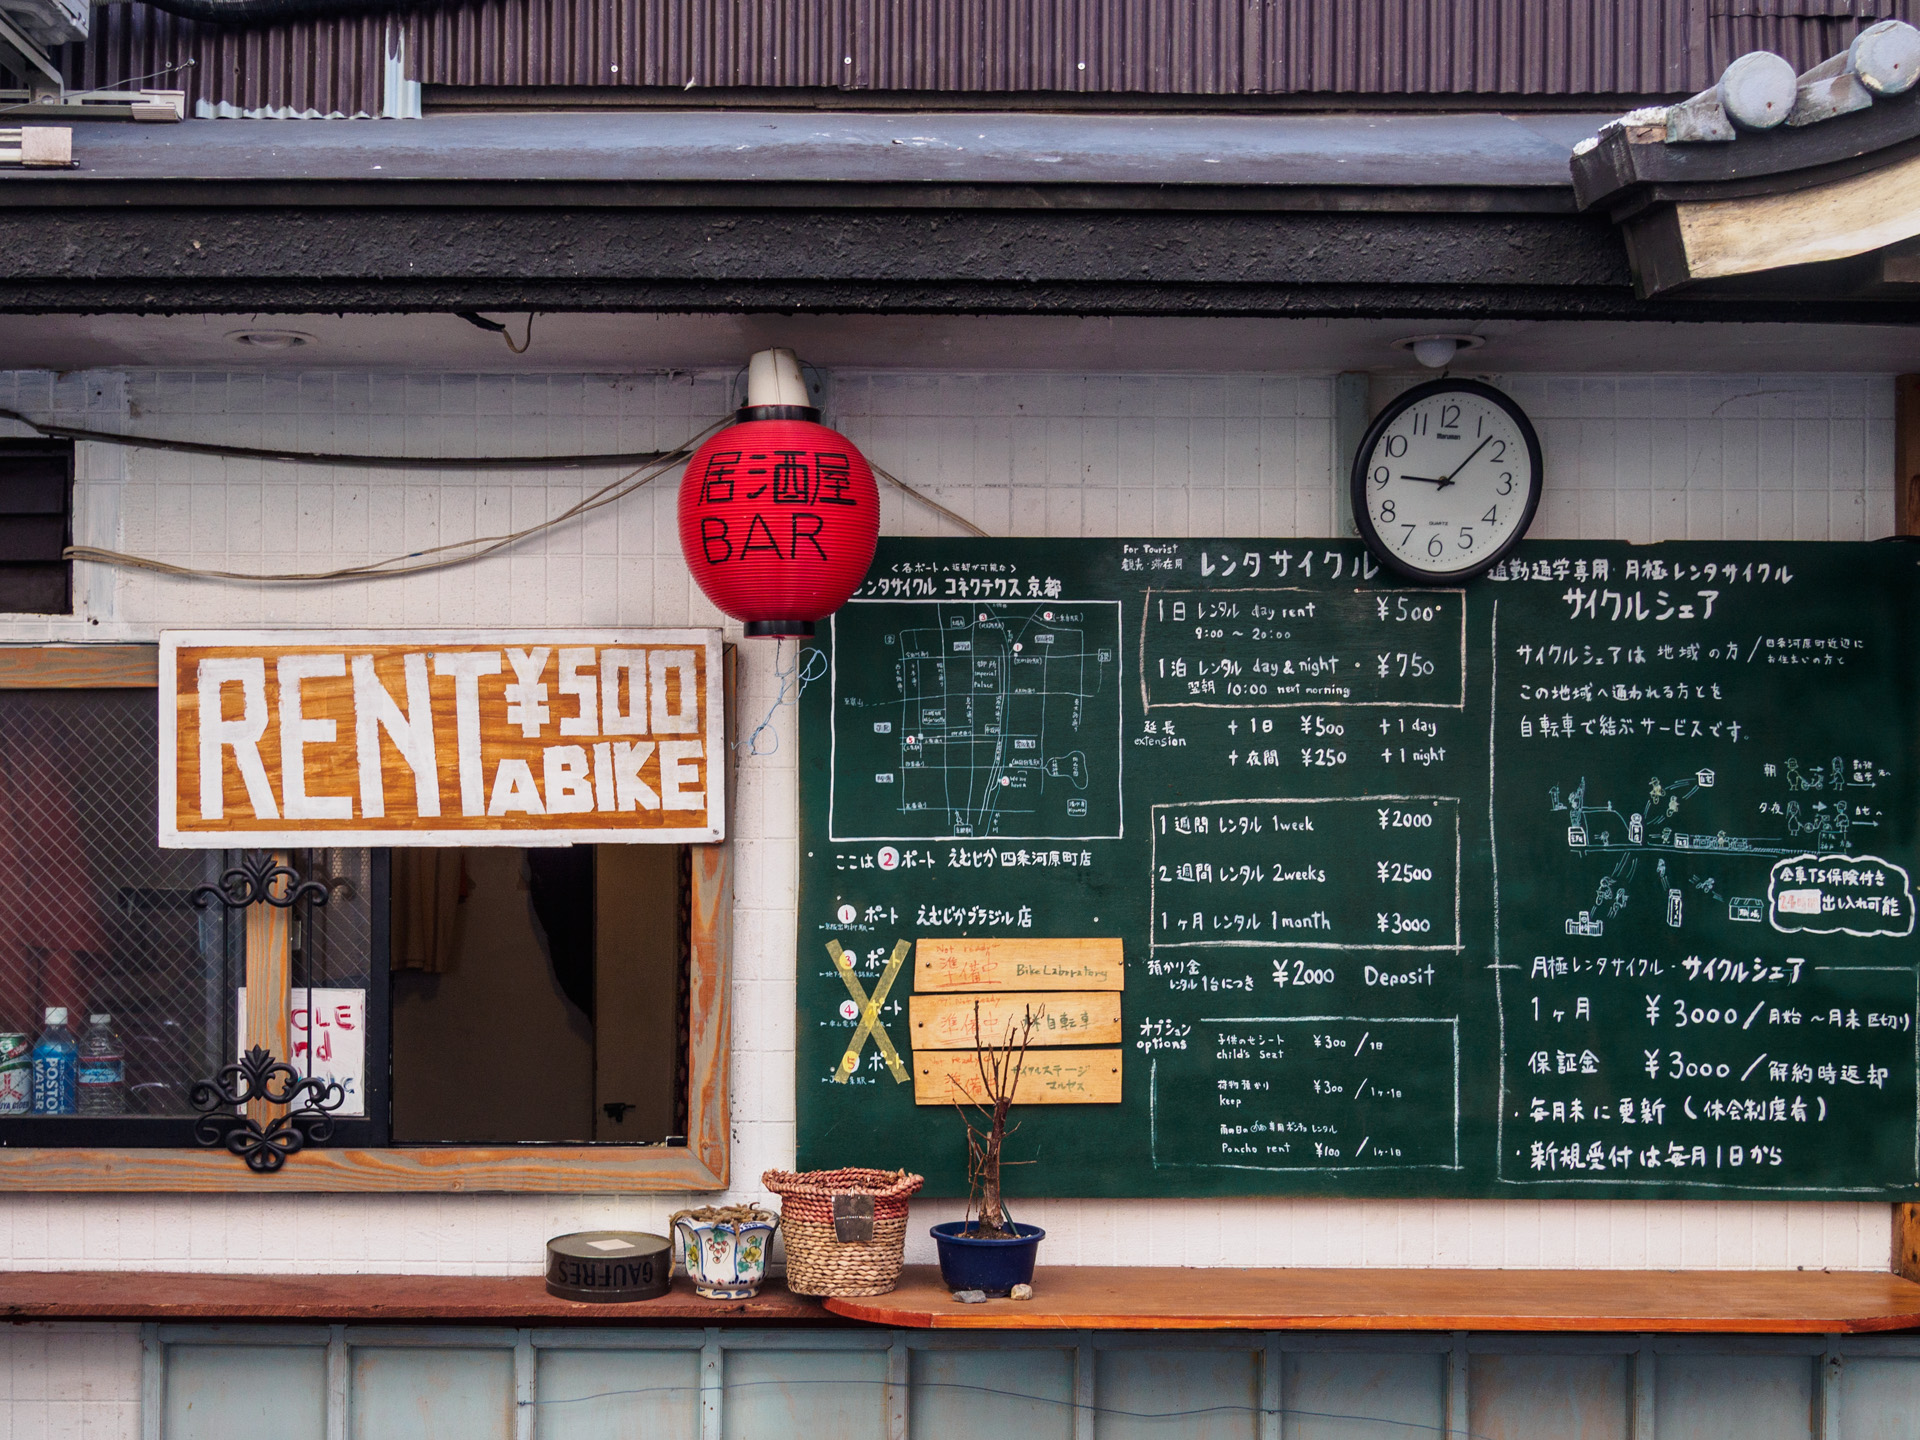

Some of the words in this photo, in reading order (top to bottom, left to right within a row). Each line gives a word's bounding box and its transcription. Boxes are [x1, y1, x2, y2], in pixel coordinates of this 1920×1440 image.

[1413, 413, 1427, 435] 11
[1441, 405, 1460, 428] 12
[1477, 415, 1482, 438] 1
[1385, 435, 1408, 457] 10
[1490, 440, 1506, 463] 2
[697, 449, 858, 507] 居酒屋
[1374, 466, 1389, 490] 9
[1496, 471, 1512, 495] 3
[1380, 500, 1396, 522] 8
[1481, 504, 1497, 526] 4
[702, 511, 829, 565] BAR
[1401, 524, 1416, 546] 7
[1428, 533, 1443, 557] 6
[1457, 527, 1473, 549] 5
[1123, 544, 1139, 554] For
[1143, 543, 1179, 554] Tourist
[1201, 551, 1383, 580] レンタサイクル
[1027, 576, 1062, 599] 京都
[1198, 601, 1240, 620] レンタル
[1251, 603, 1274, 620] day
[1282, 602, 1316, 618] rent
[1376, 596, 1434, 622] ¥500
[1563, 588, 1720, 622] サイクルシェア
[1195, 627, 1223, 640] 9:00
[1251, 628, 1291, 640] 20:00
[1199, 658, 1242, 677] レンタル
[1253, 659, 1279, 677] day
[1299, 657, 1340, 677] night
[1377, 652, 1435, 678] ¥750
[1188, 679, 1216, 695] 翌朝
[1227, 681, 1268, 696] 10:00
[1277, 682, 1300, 695] next
[198, 650, 506, 820] RENT
[504, 646, 700, 738] ¥500
[1144, 720, 1176, 735] 延長
[1301, 715, 1344, 737] ¥500
[1412, 719, 1437, 737] day
[1134, 735, 1187, 748] extension
[1246, 750, 1279, 767] 夜間
[1301, 748, 1347, 767] ¥250
[1412, 748, 1446, 766] night
[543, 740, 706, 813] BIKE
[1763, 763, 1777, 777] 朝
[1219, 817, 1262, 833] レンタル
[1377, 808, 1432, 830] ¥2000
[1219, 865, 1264, 883] レンタル
[1377, 860, 1432, 883] ¥2500
[864, 905, 898, 925] ポート
[1213, 913, 1261, 930] レンタル
[1377, 912, 1430, 933] ¥3000
[1016, 963, 1040, 976] Bike
[1147, 960, 1200, 976] 預かり金
[1272, 959, 1335, 987] ¥2000
[1364, 966, 1435, 988] Deposit
[1140, 1017, 1191, 1037] オプション
[1137, 1038, 1187, 1054] options
[1313, 1034, 1346, 1048] ¥300
[1216, 1049, 1250, 1059] child's
[1528, 1051, 1600, 1075] 保証金
[36, 1059, 44, 1110] WATER
[1313, 1079, 1343, 1094] ¥300
[1219, 1094, 1241, 1108] keep
[1222, 1143, 1257, 1153] Poncho
[1267, 1142, 1291, 1153] rent
[1314, 1142, 1340, 1158] ¥100
[559, 1261, 653, 1287] GAUFRES
